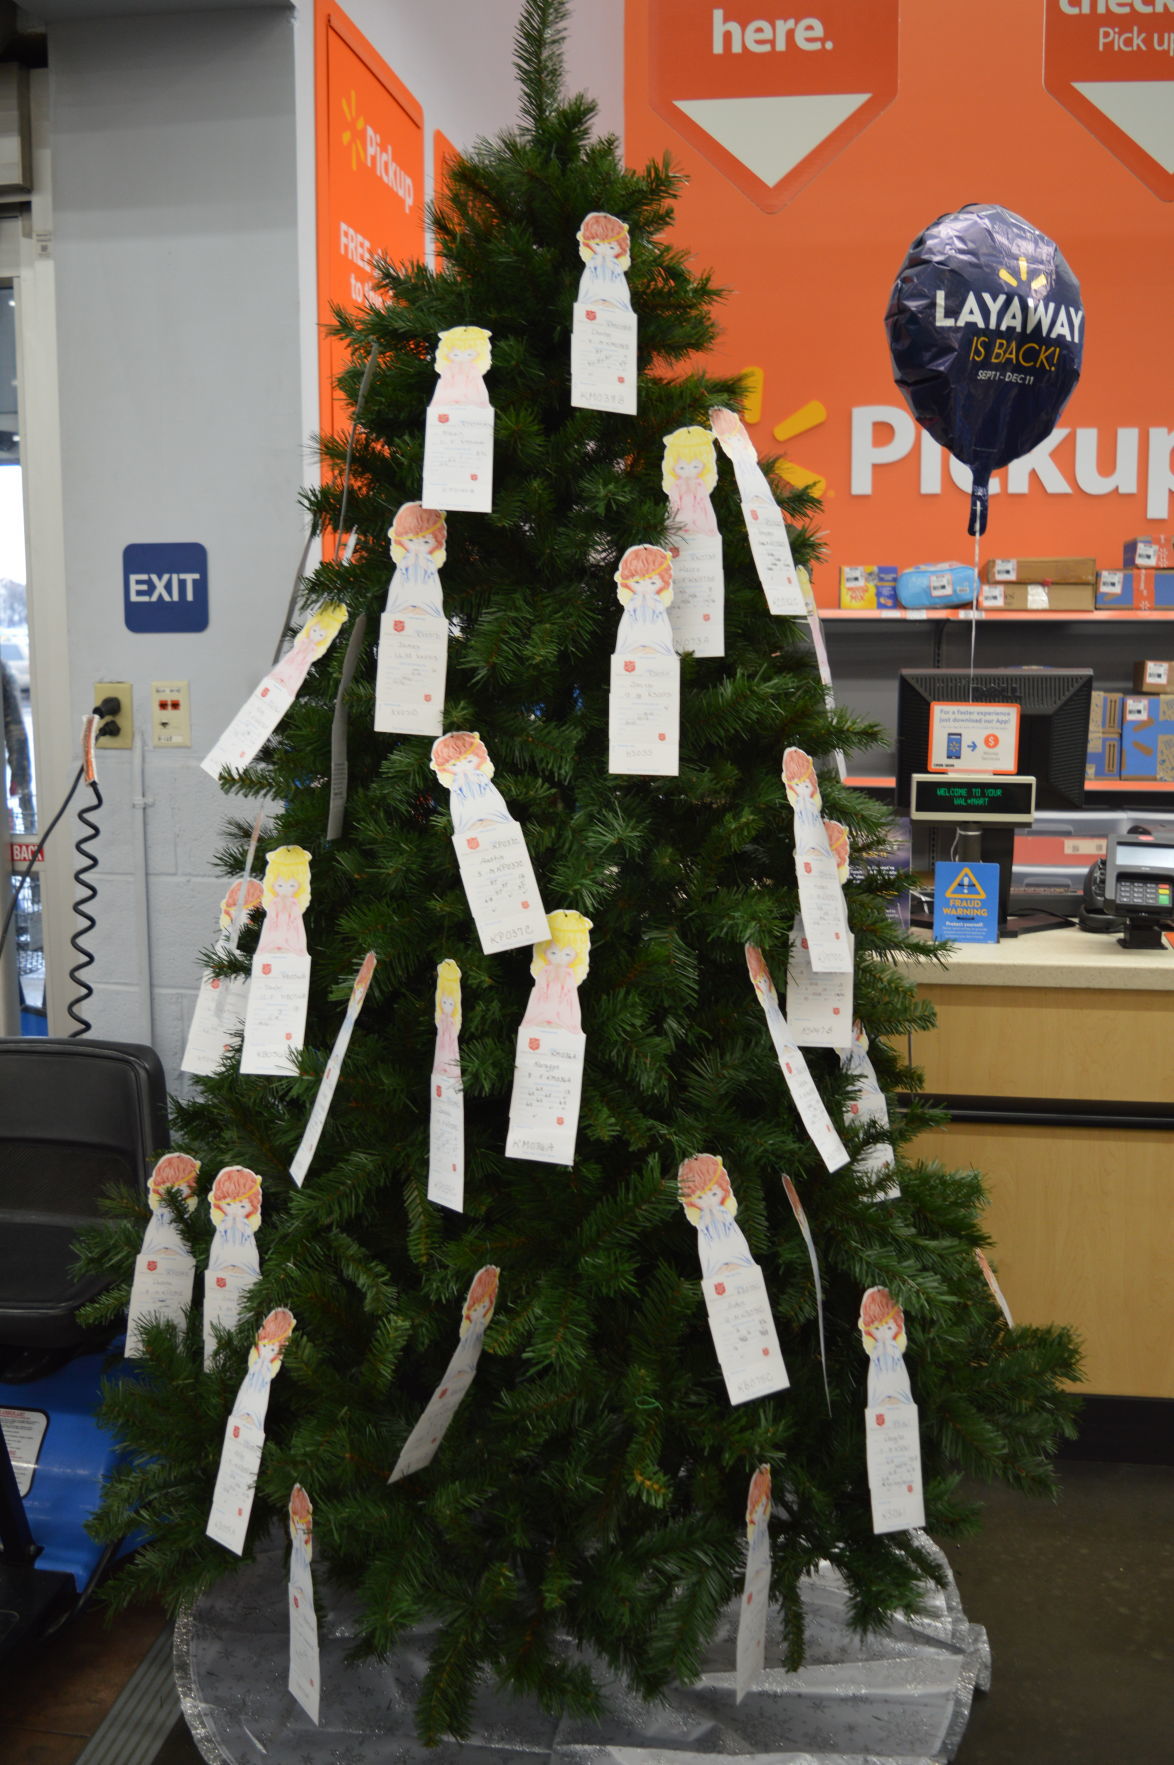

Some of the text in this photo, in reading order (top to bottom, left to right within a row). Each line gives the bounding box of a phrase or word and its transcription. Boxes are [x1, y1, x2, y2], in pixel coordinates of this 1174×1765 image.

[713, 8, 833, 54] here.
[1098, 25, 1147, 51] Pick
[366, 124, 414, 215] Pickup
[339, 220, 371, 274] FREE
[351, 272, 363, 303] to
[935, 289, 1083, 344] LAYAWAY
[969, 336, 1060, 371] IS BACK!
[1005, 371, 1024, 384] DEC
[129, 573, 200, 602] EXIT
[936, 787, 1003, 797] WELCOME TO YOUR
[942, 907, 988, 917] WARNING
[949, 899, 982, 908] FRAUD
